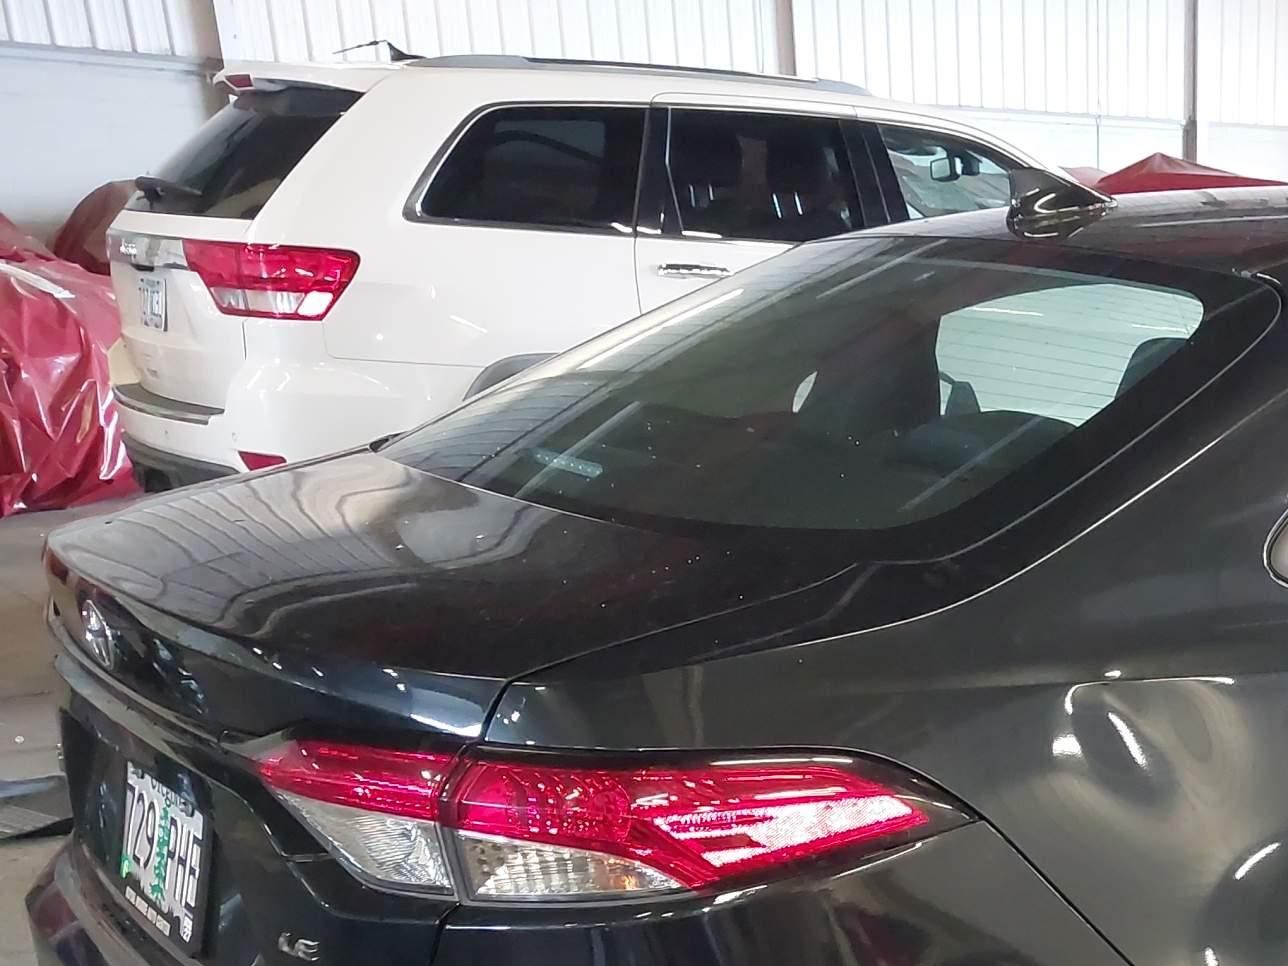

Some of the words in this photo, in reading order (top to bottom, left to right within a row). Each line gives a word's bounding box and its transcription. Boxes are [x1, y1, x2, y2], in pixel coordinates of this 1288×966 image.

[126, 781, 156, 869] 729
[165, 816, 203, 910] PHE
[278, 932, 320, 961] LE
